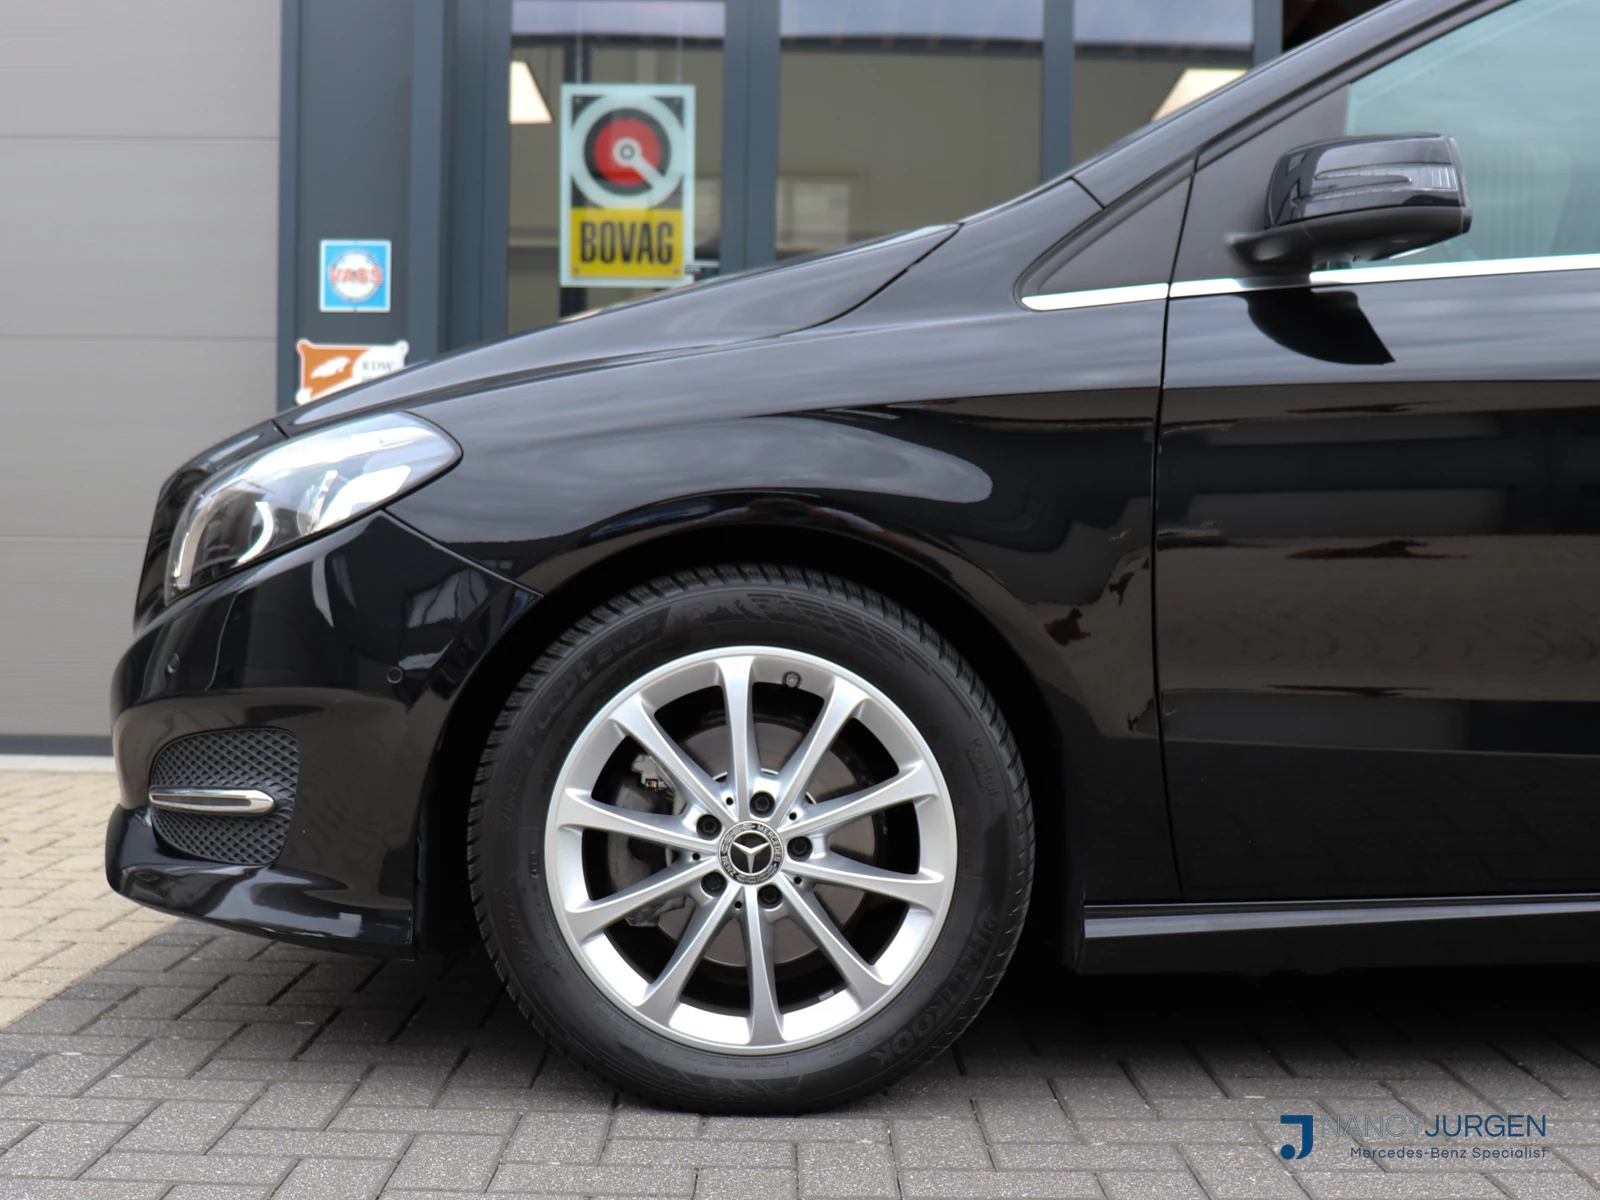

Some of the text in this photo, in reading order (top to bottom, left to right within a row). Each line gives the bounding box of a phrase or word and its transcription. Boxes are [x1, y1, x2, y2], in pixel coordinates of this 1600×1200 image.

[581, 221, 673, 264] BOVAG
[328, 267, 384, 285] VASS
[756, 823, 782, 863] MERCEDES
[721, 855, 737, 877] BENZ
